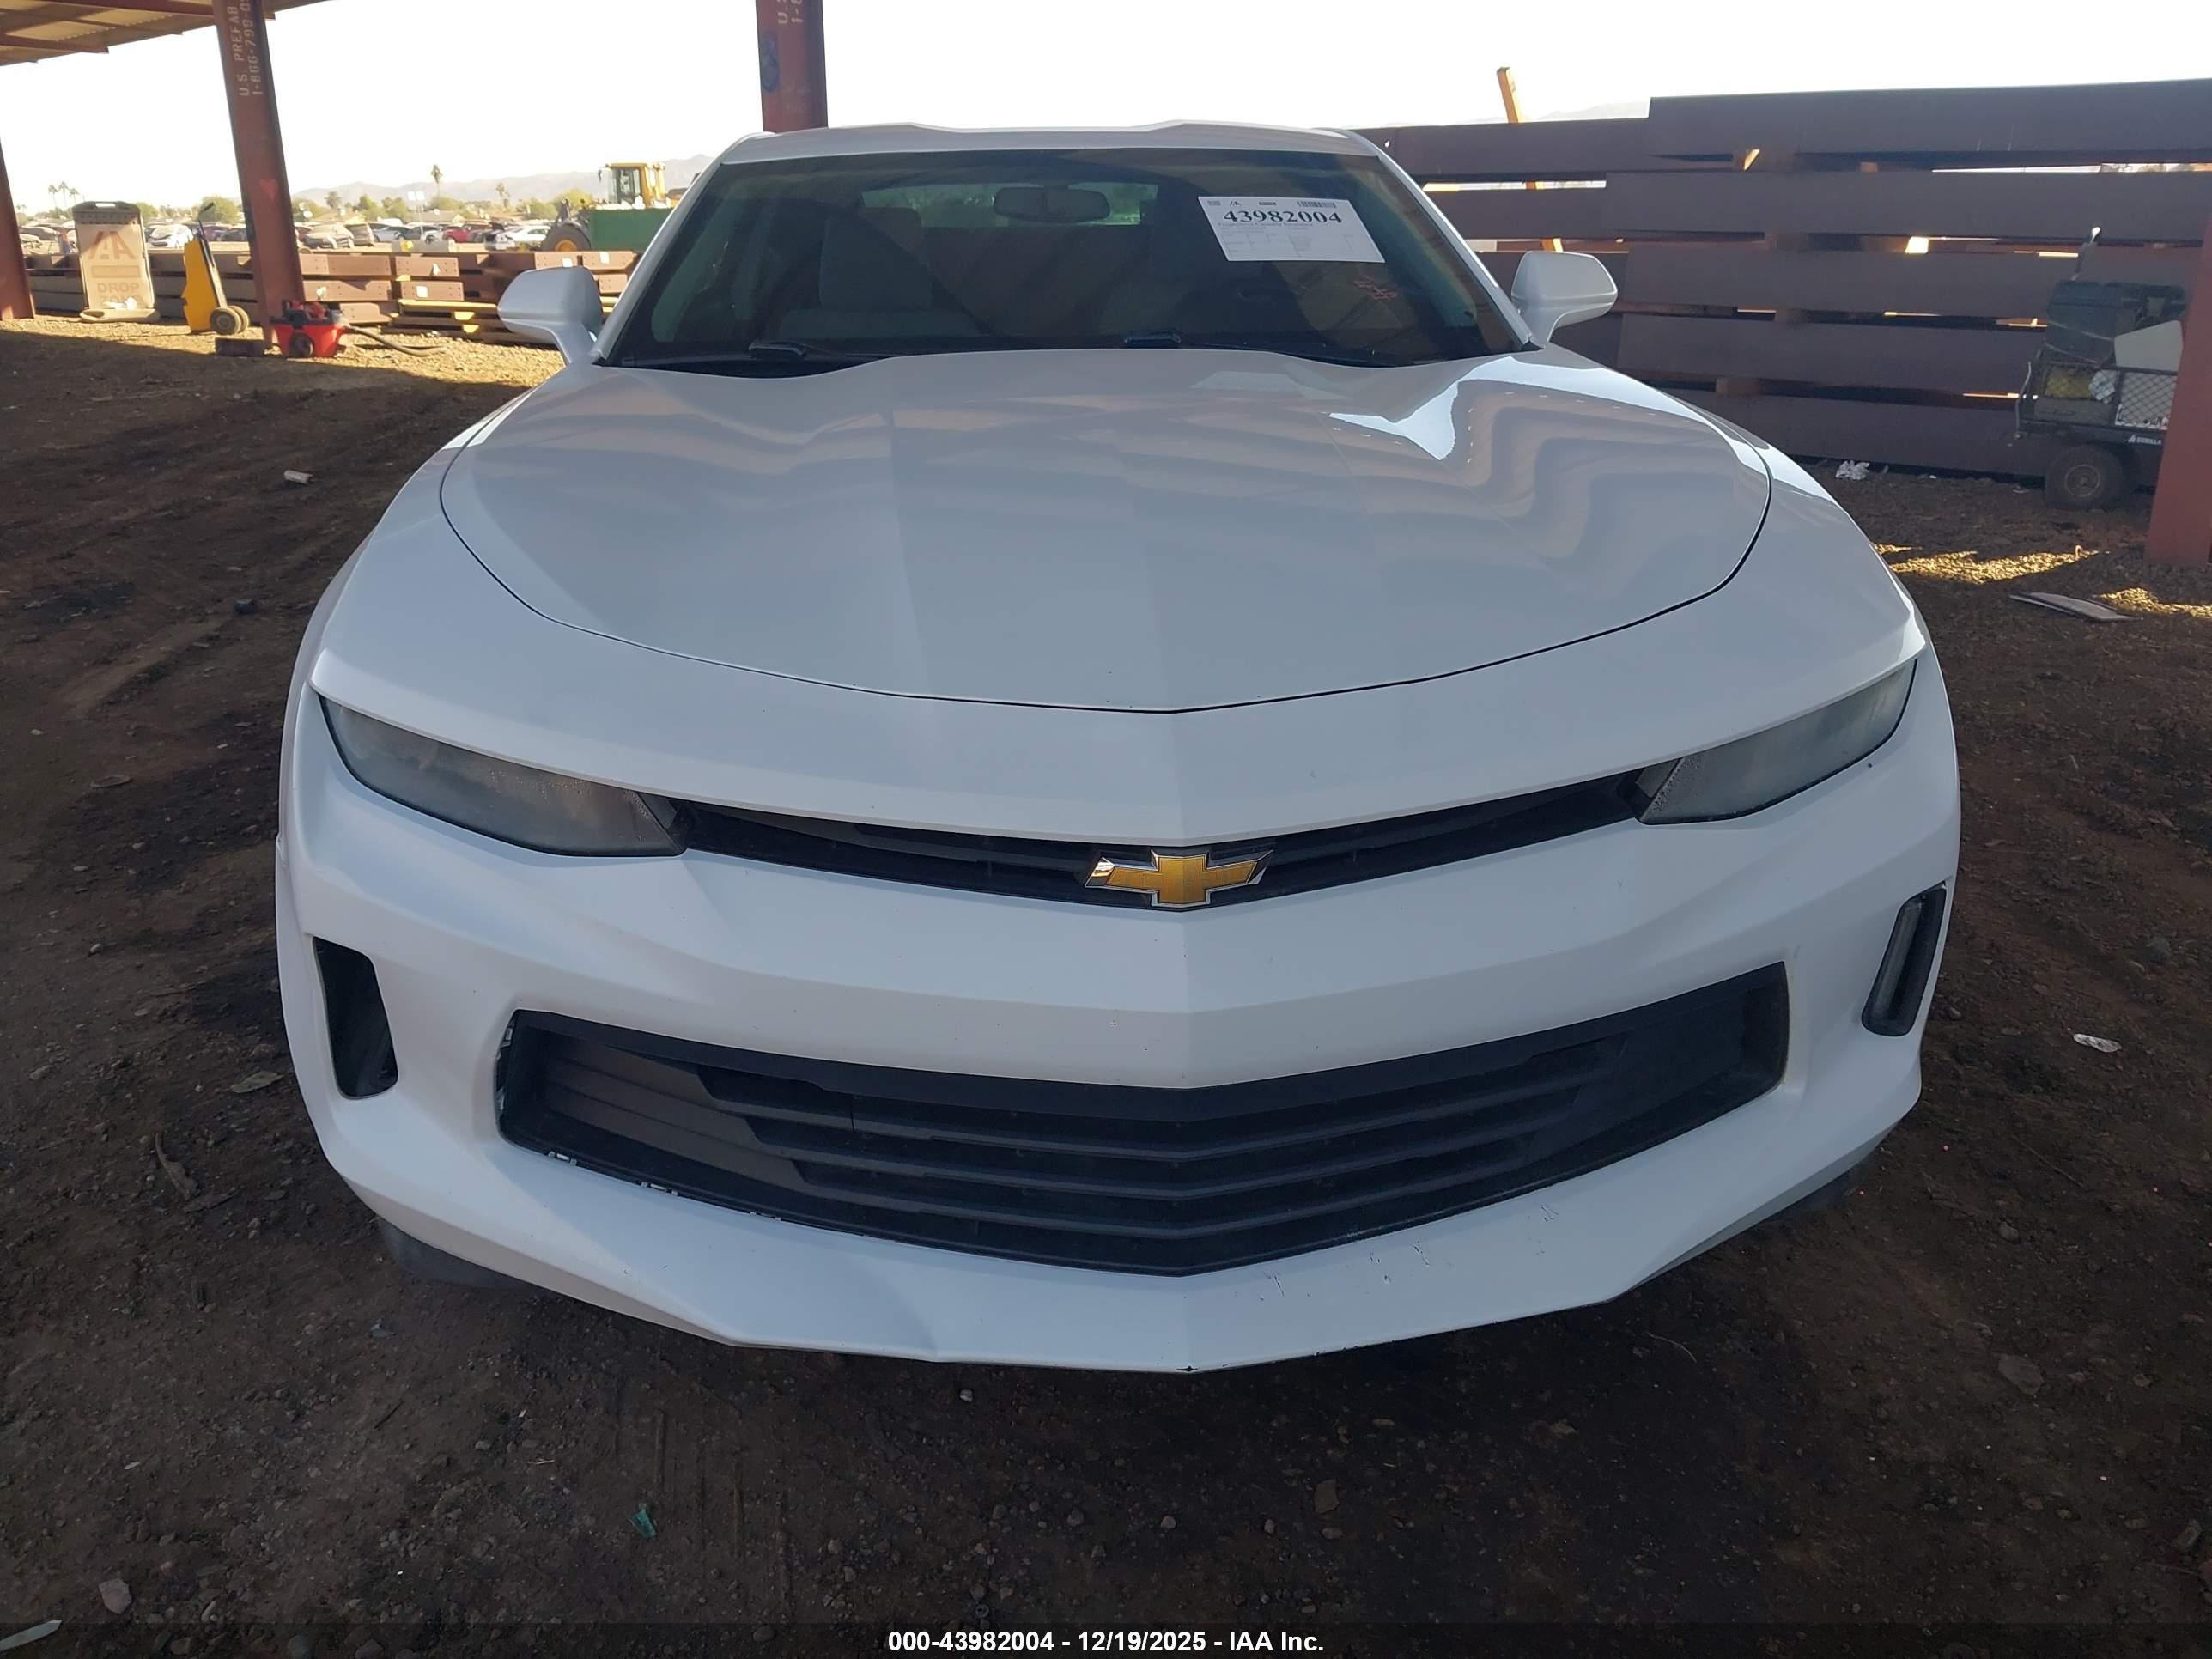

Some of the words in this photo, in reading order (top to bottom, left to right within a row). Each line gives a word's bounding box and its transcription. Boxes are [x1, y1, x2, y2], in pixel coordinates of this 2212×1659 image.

[227, 6, 244, 61] PREFAB
[240, 0, 263, 94] 1-866-799-0
[1224, 210, 1342, 223] 43982004
[98, 283, 139, 294] DROP
